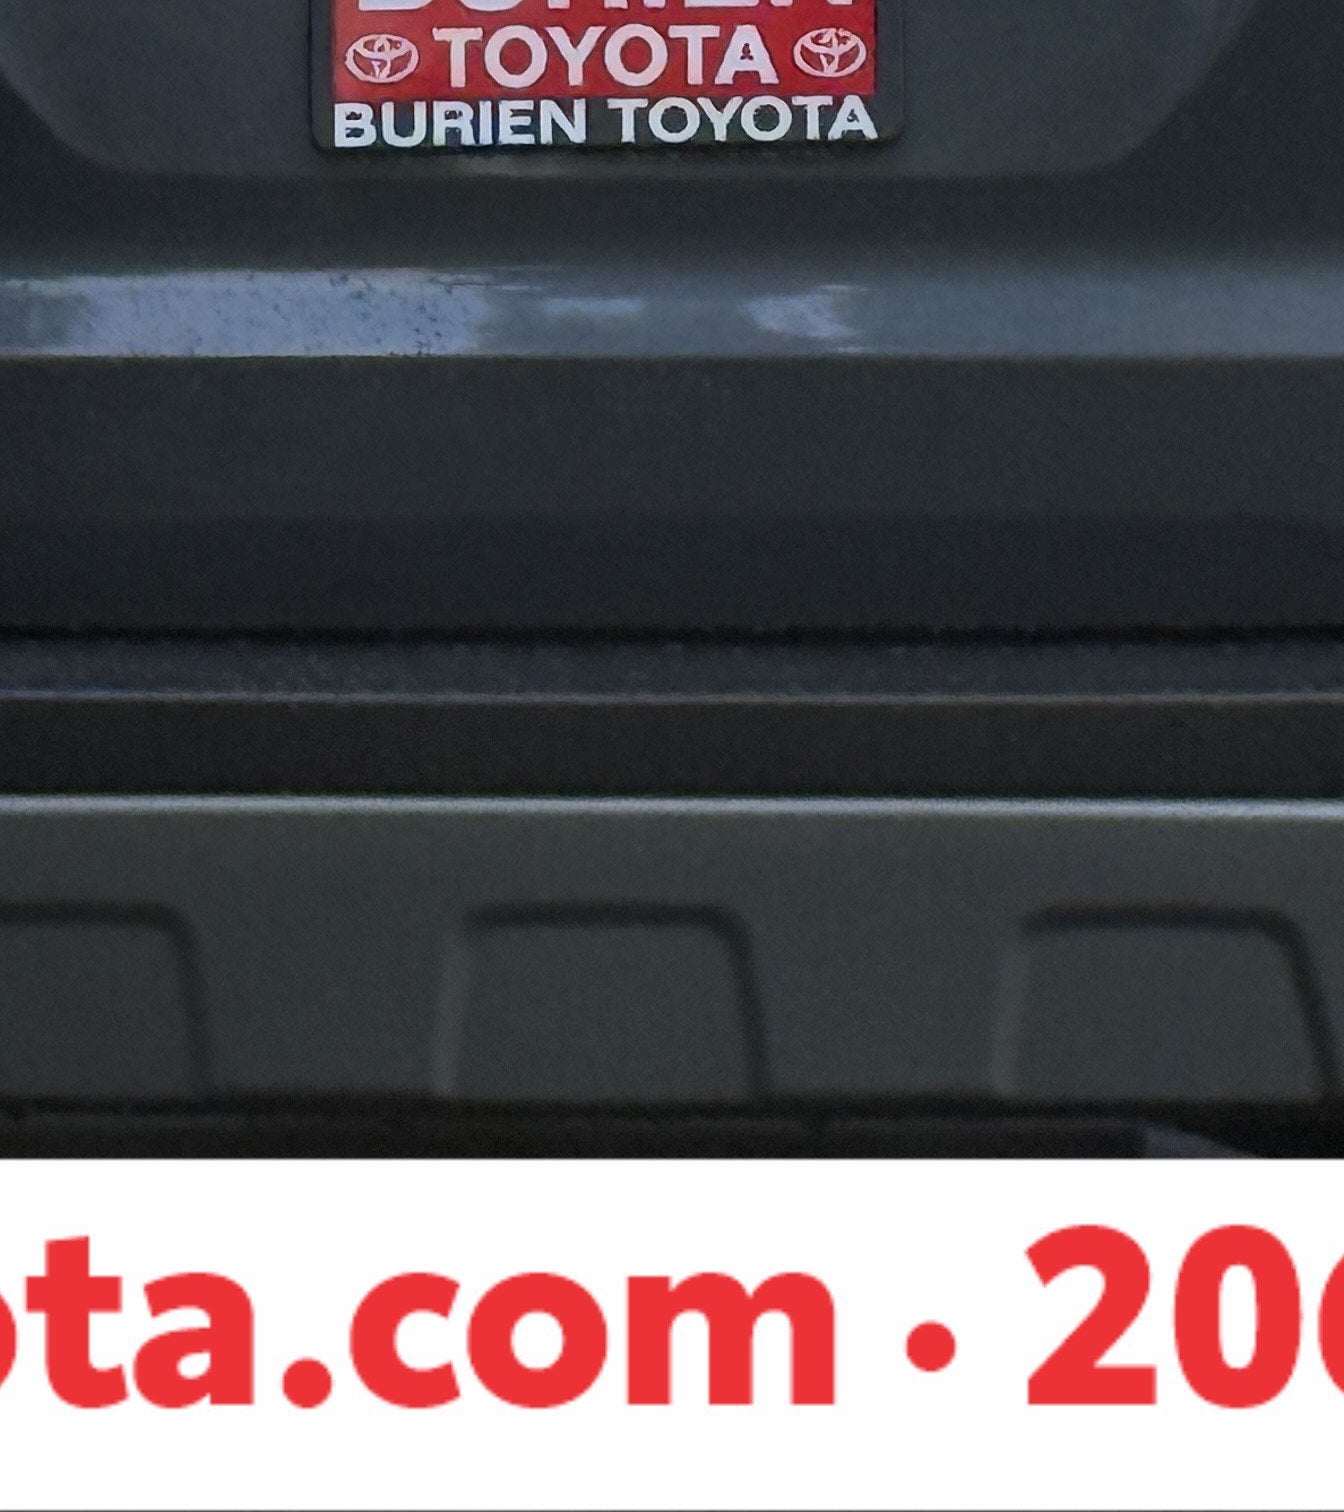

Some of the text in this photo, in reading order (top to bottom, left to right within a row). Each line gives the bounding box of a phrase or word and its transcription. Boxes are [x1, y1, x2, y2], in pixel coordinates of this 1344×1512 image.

[432, 23, 779, 87] TOYOTA
[333, 95, 878, 147] BURIEN TOYOTA
